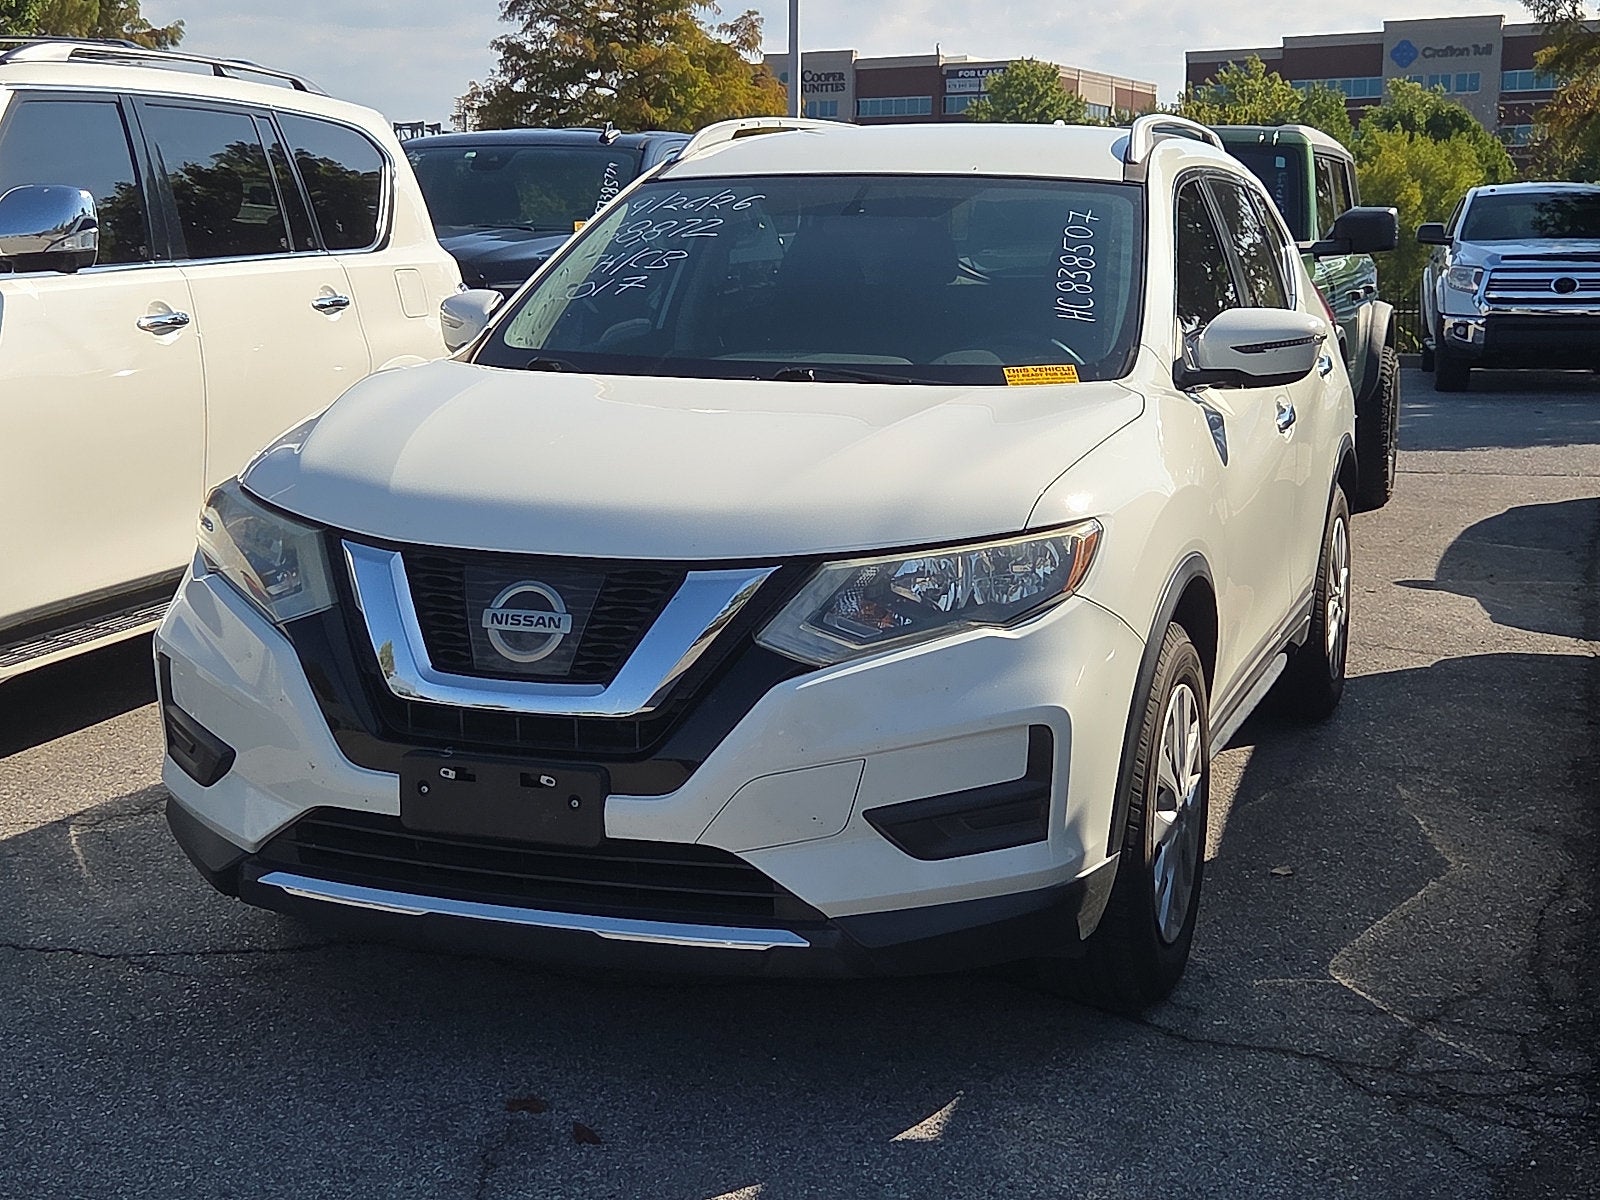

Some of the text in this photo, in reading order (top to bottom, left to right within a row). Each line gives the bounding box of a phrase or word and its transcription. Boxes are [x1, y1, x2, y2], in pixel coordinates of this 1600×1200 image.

[1422, 43, 1493, 58] Crafton Tull
[958, 69, 1004, 78] FOR LEASE
[1053, 209, 1100, 322] HC838507
[490, 613, 561, 629] NISSAN
